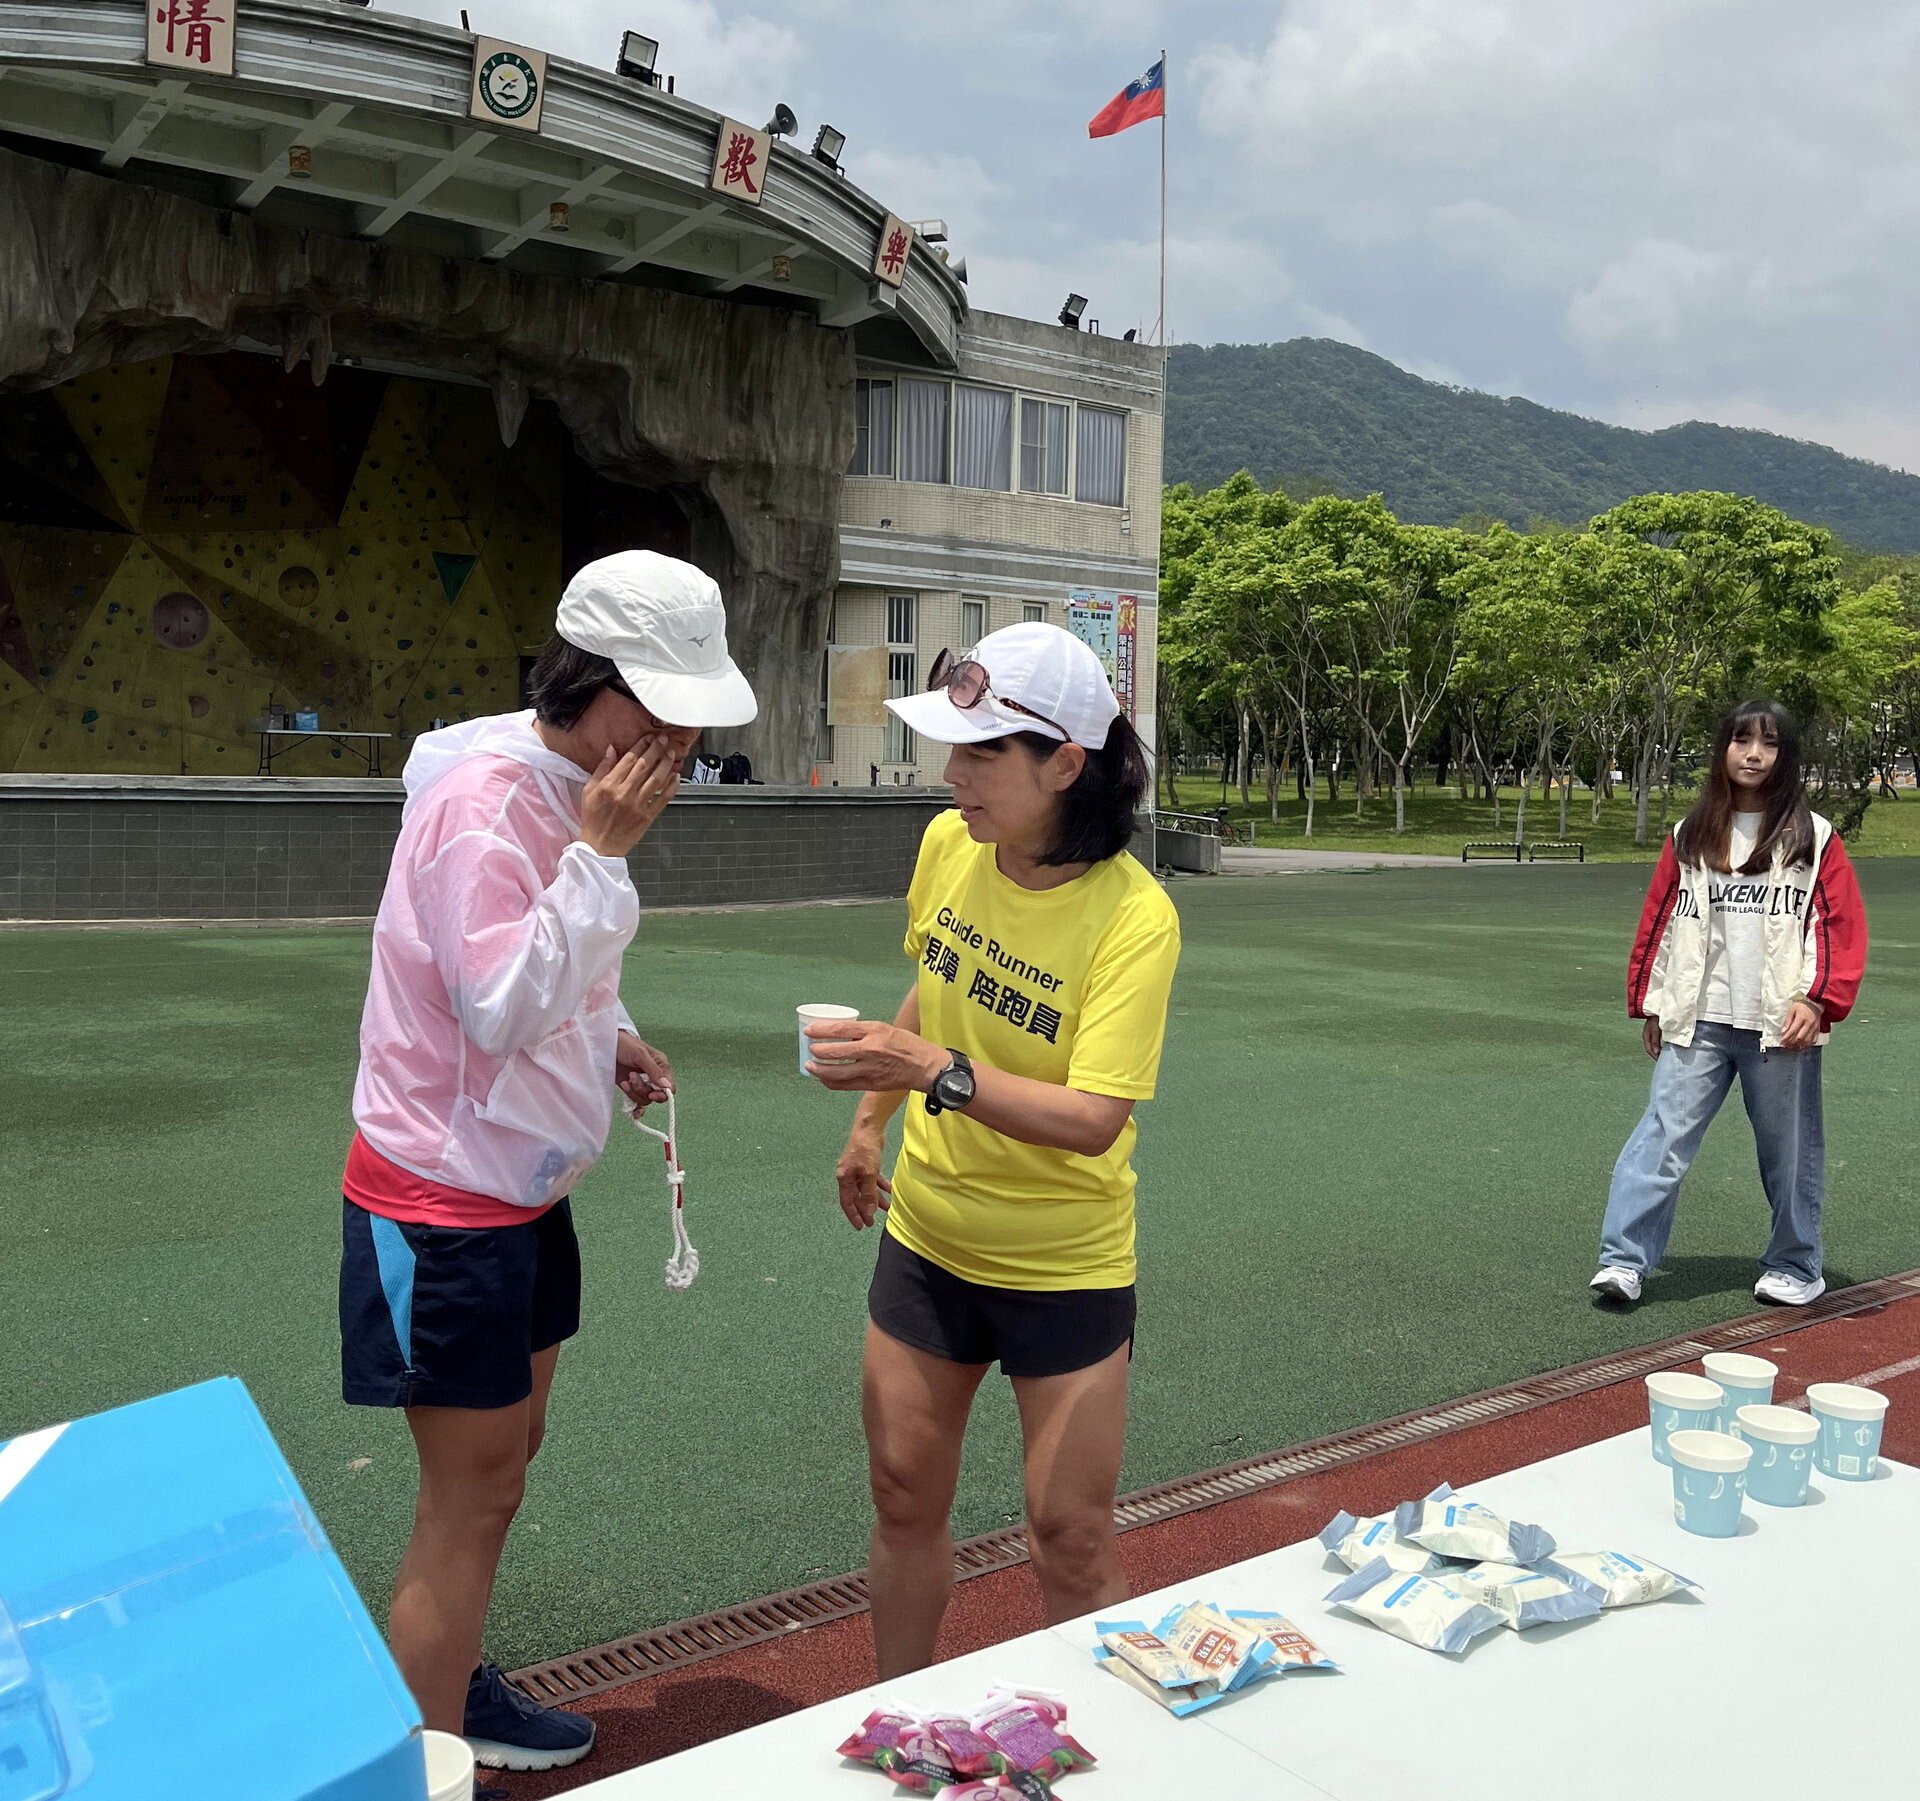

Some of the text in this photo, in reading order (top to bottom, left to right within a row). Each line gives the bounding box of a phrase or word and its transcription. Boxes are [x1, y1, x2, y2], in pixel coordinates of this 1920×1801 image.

[157, 0, 225, 63] 情
[720, 132, 757, 193] 歡
[882, 227, 907, 275] 樂
[937, 907, 1063, 993] Guide Runner
[967, 967, 1063, 1045] 陪跑員
